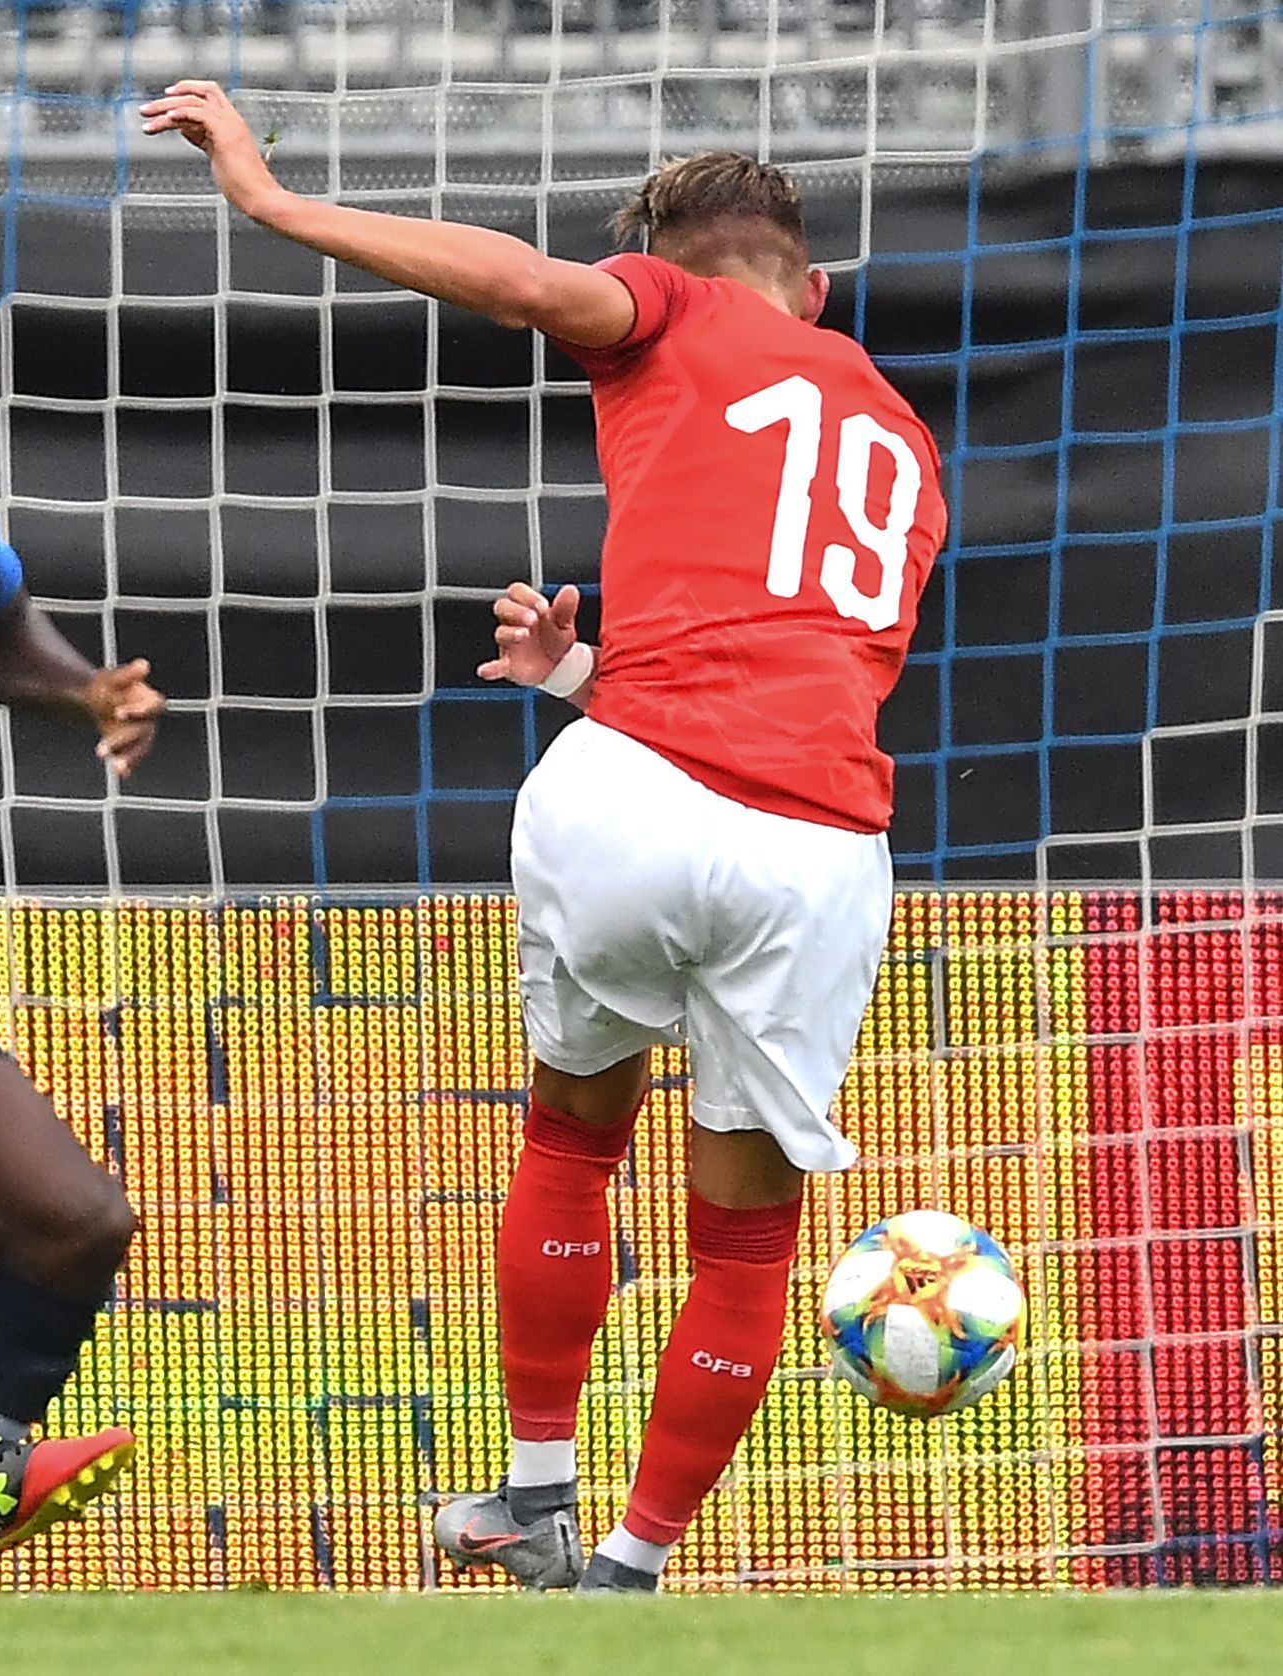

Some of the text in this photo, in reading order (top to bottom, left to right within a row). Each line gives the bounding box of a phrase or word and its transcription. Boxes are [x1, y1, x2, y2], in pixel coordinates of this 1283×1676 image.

[724, 374, 922, 632] 19
[541, 1239, 601, 1258] ÖFB
[691, 1350, 752, 1377] ÖFB
